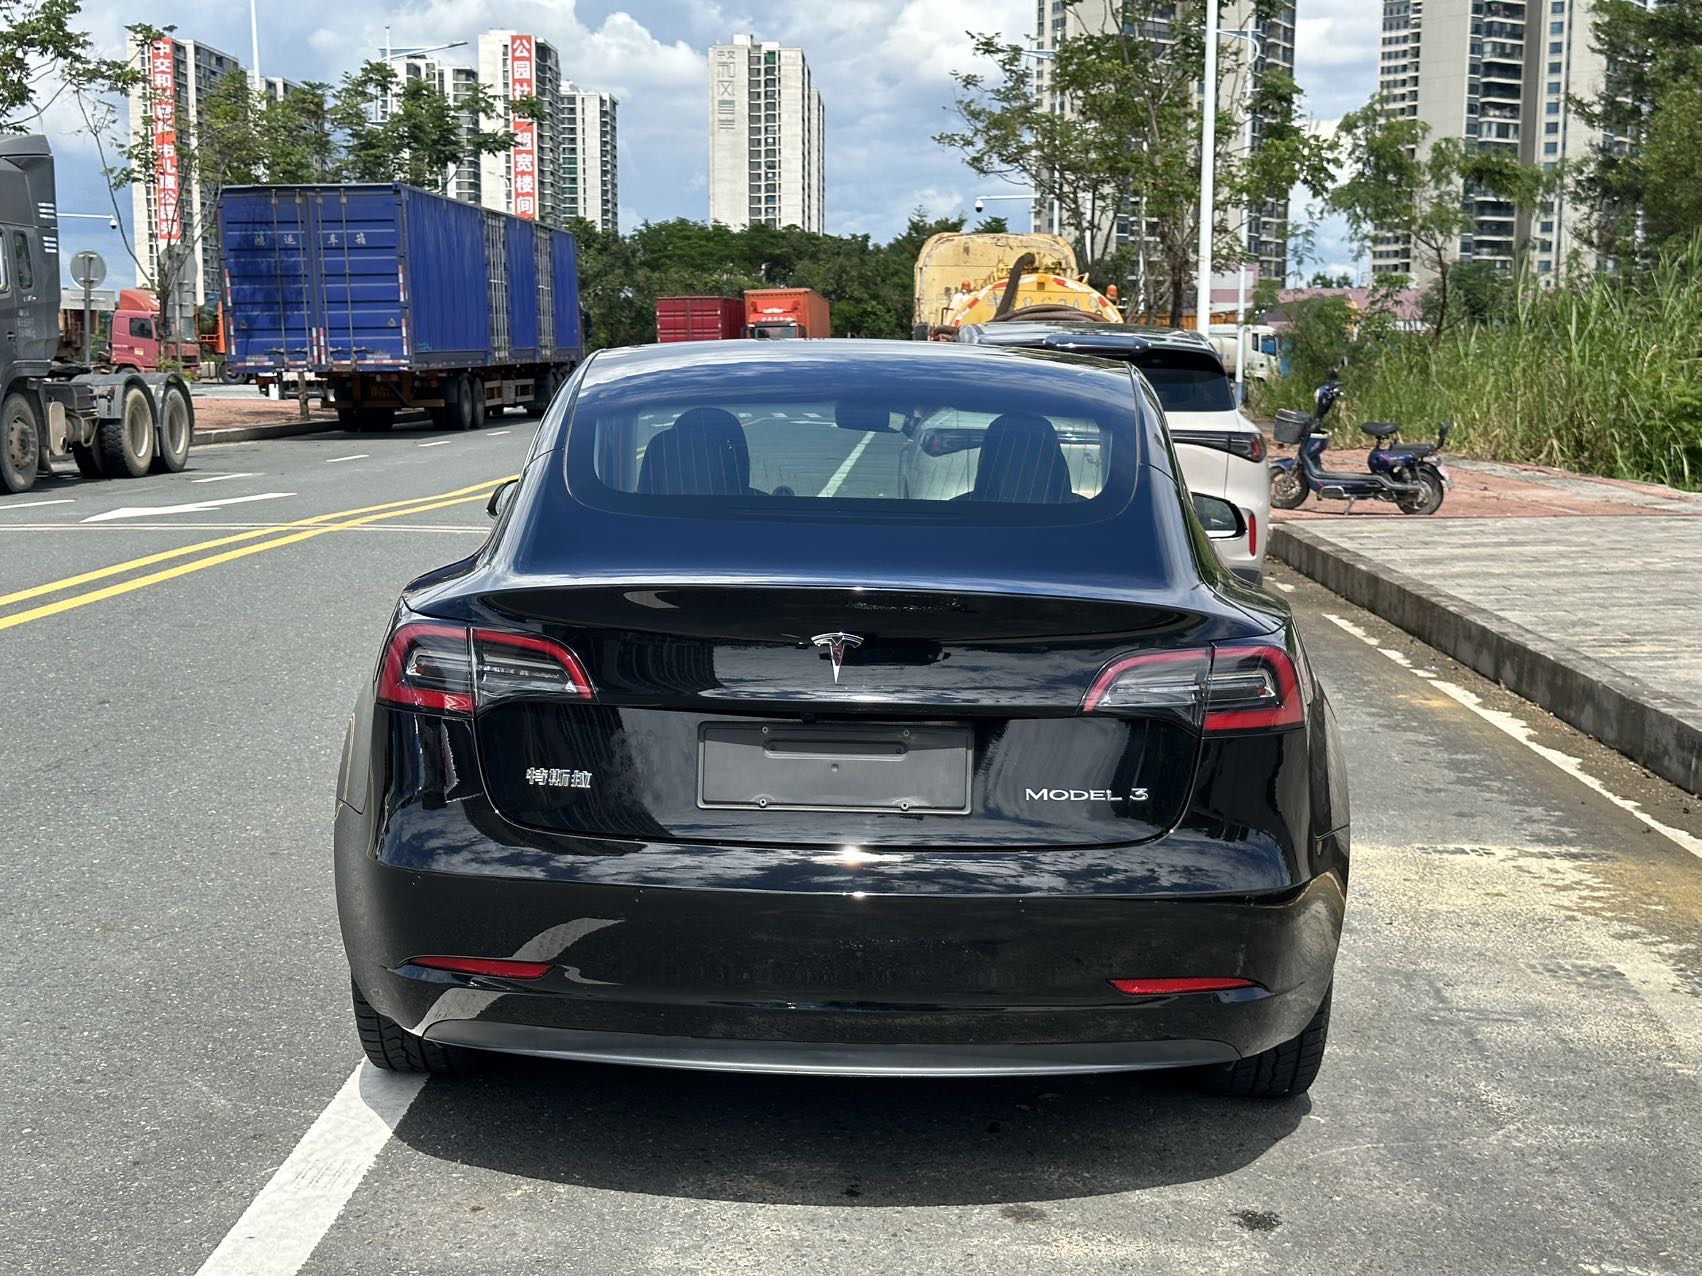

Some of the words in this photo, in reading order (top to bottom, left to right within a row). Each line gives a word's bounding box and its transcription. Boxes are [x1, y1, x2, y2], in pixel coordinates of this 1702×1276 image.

[525, 766, 593, 789] 特斯拉
[1025, 788, 1123, 801] MODEL
[1129, 787, 1149, 801] 3
